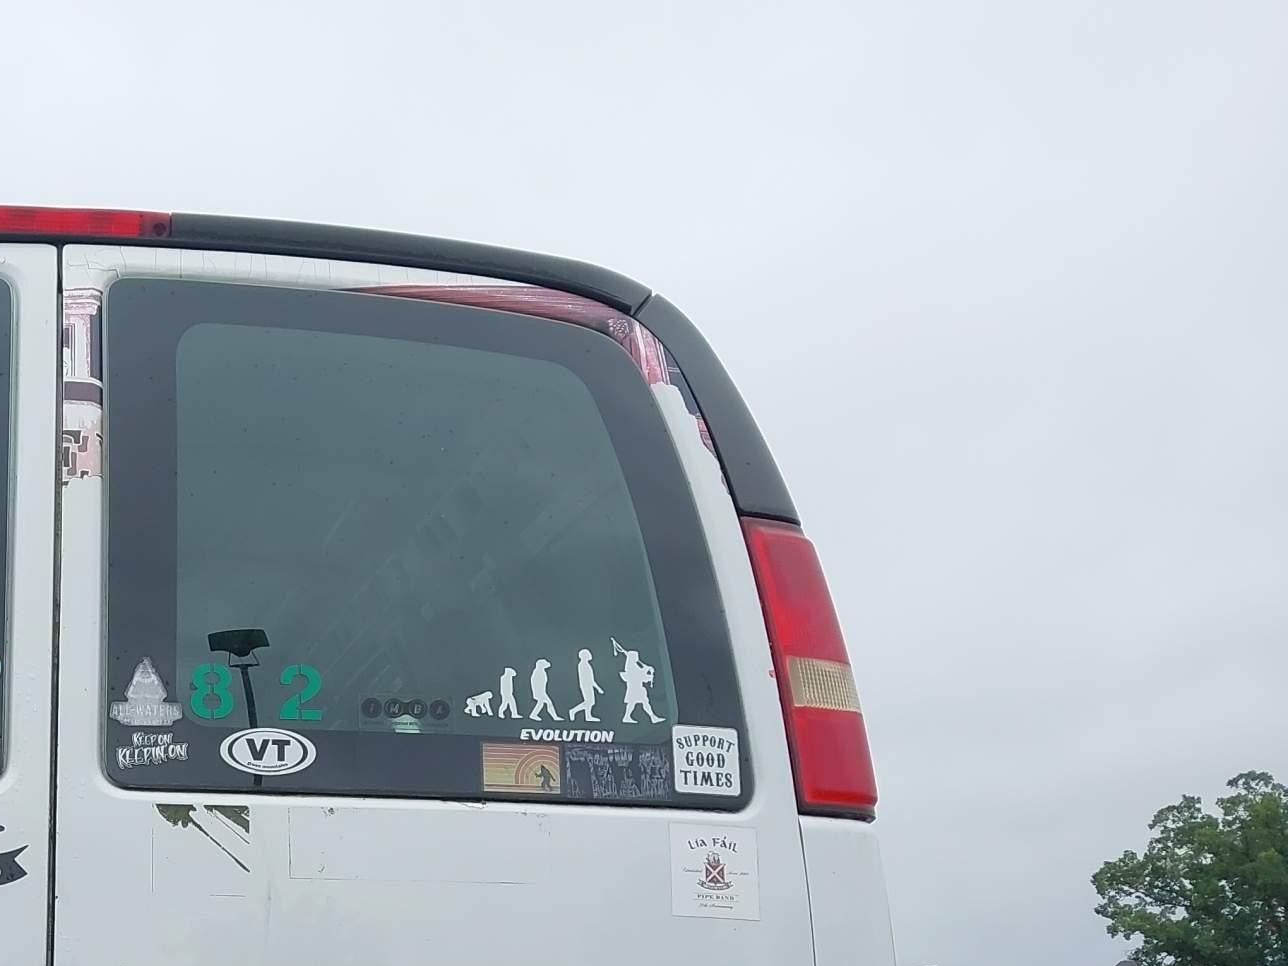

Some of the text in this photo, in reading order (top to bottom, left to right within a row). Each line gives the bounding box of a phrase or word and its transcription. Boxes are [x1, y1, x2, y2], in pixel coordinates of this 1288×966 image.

[190, 663, 322, 721] 8 2
[111, 703, 180, 717] ALL-WATERS
[132, 732, 157, 747] KEEP
[519, 728, 615, 743] EVOLUTION
[676, 734, 735, 752] SUPPORT
[245, 738, 291, 761] VT
[686, 751, 725, 768] GOOD
[680, 769, 732, 788] TIMES
